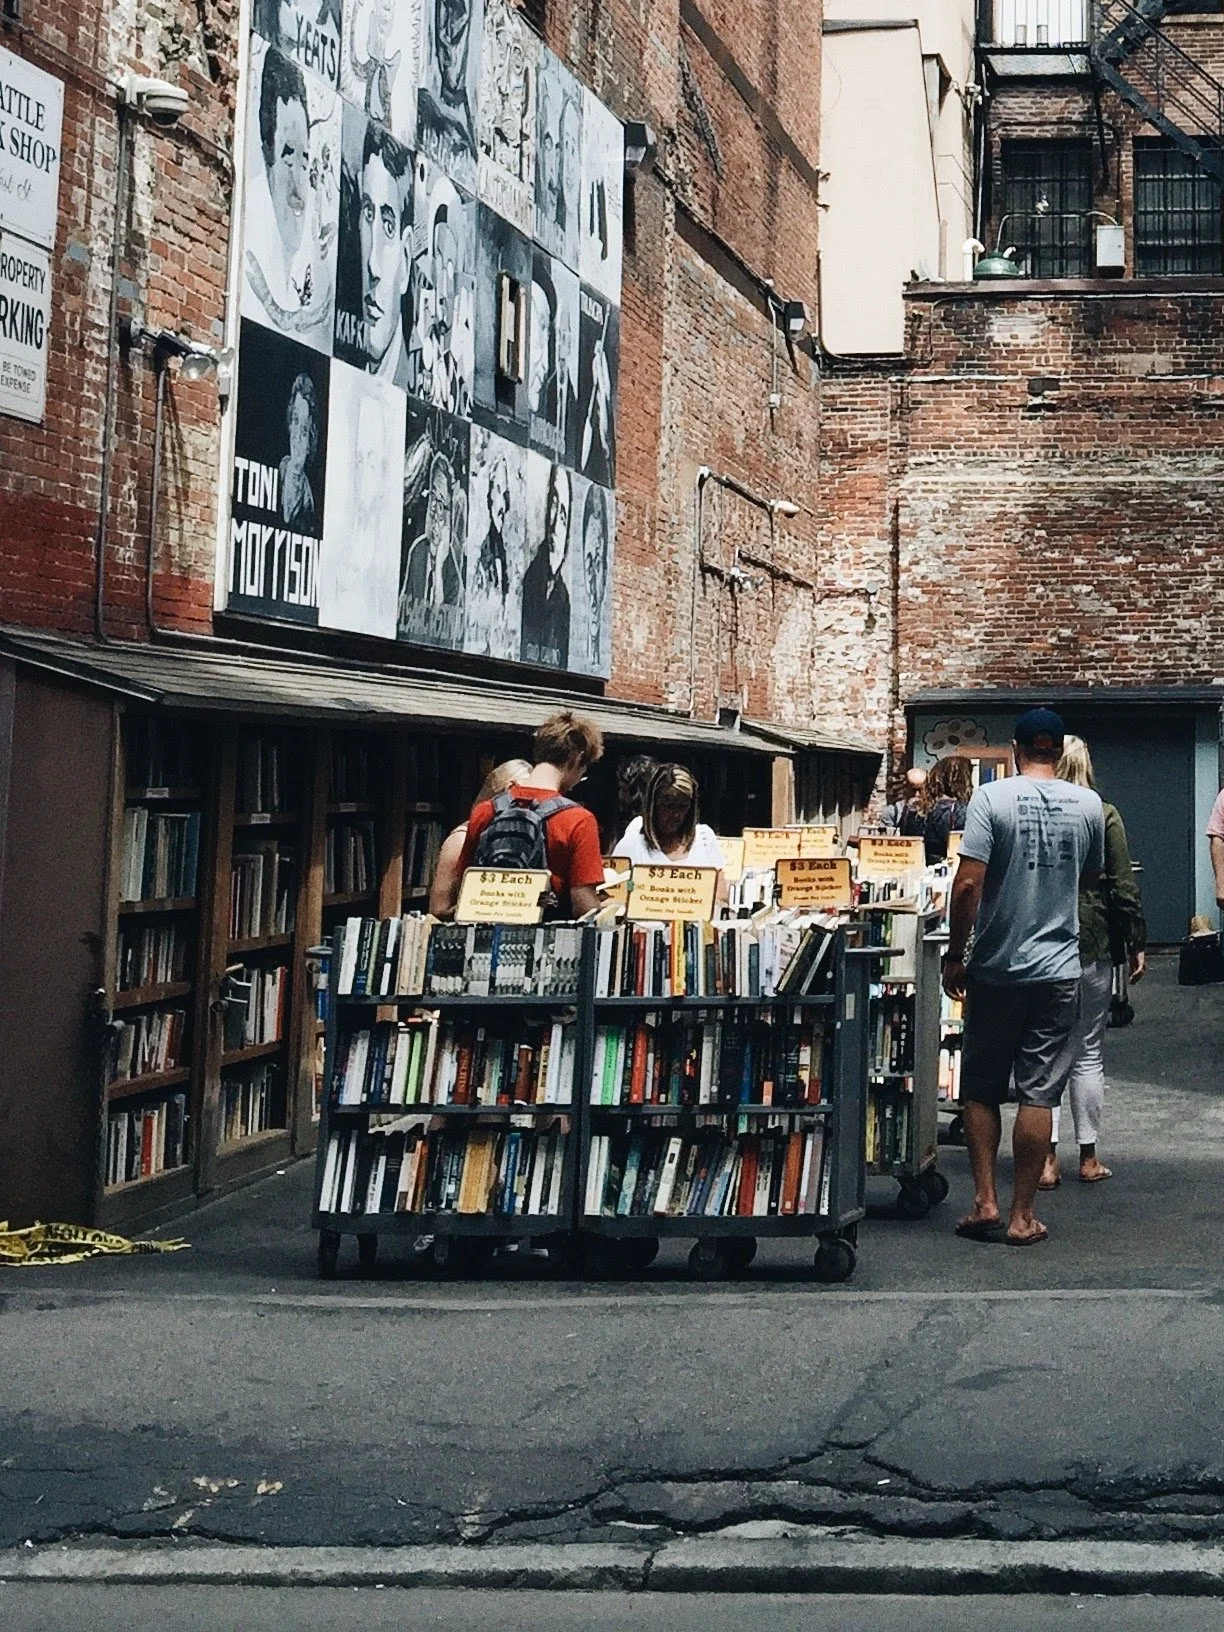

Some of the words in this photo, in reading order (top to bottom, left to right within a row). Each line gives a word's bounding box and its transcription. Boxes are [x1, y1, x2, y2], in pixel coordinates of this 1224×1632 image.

[9, 126, 57, 174] SHOP
[14, 364, 36, 382] TOWED
[234, 456, 279, 512] TONI
[808, 860, 837, 871] Each
[480, 871, 496, 884] $3
[500, 872, 533, 885] Each
[648, 867, 665, 879] $3
[669, 867, 702, 881] Each
[507, 890, 526, 898] with
[650, 885, 675, 893] Books
[677, 887, 696, 895] with
